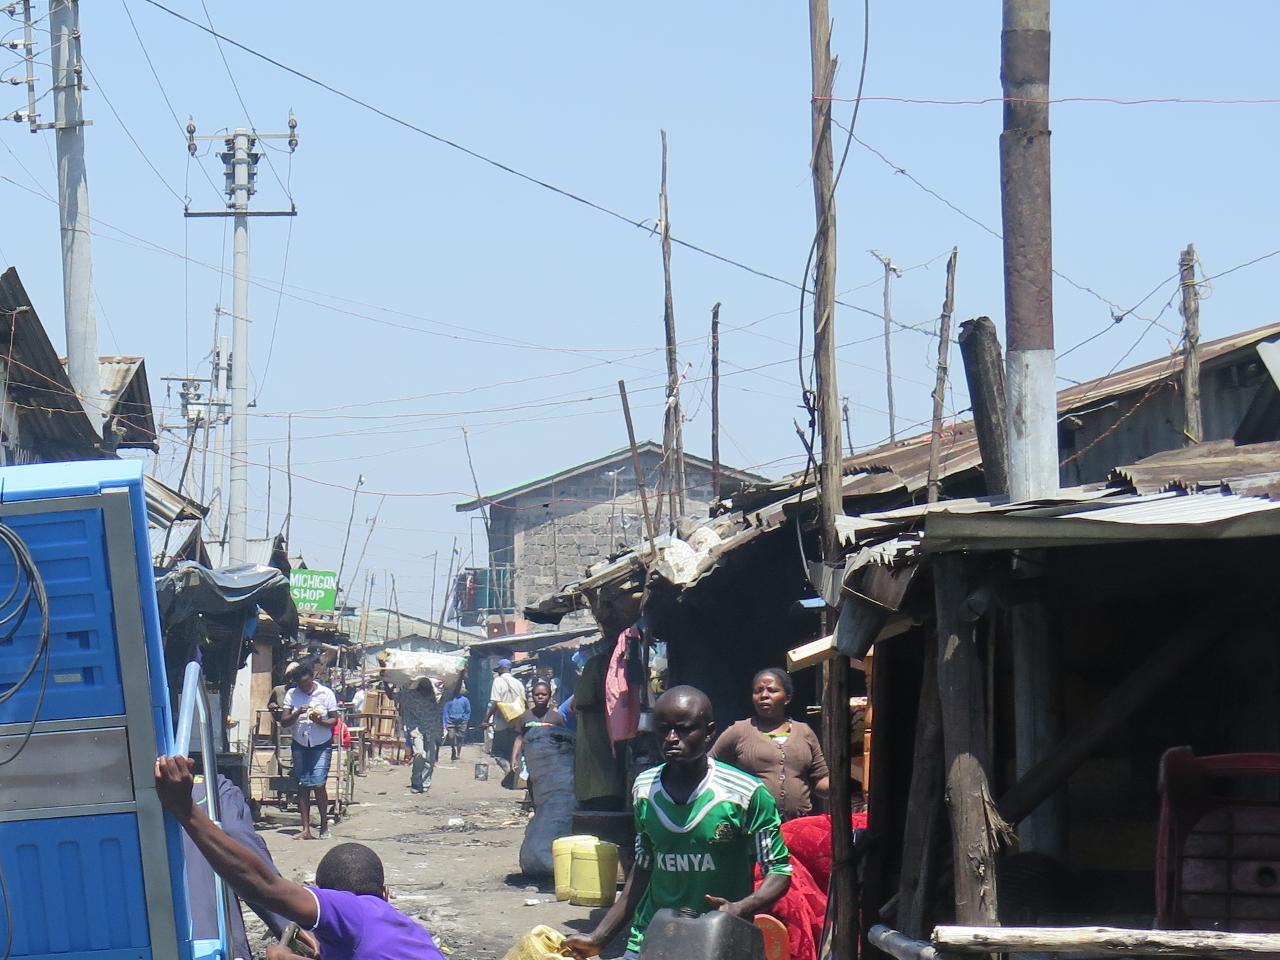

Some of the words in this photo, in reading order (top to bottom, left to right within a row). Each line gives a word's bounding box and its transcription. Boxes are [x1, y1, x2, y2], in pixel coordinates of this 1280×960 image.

[290, 573, 337, 590] MICHIGAN
[293, 588, 325, 601] SHOP
[657, 853, 716, 872] KENYA
